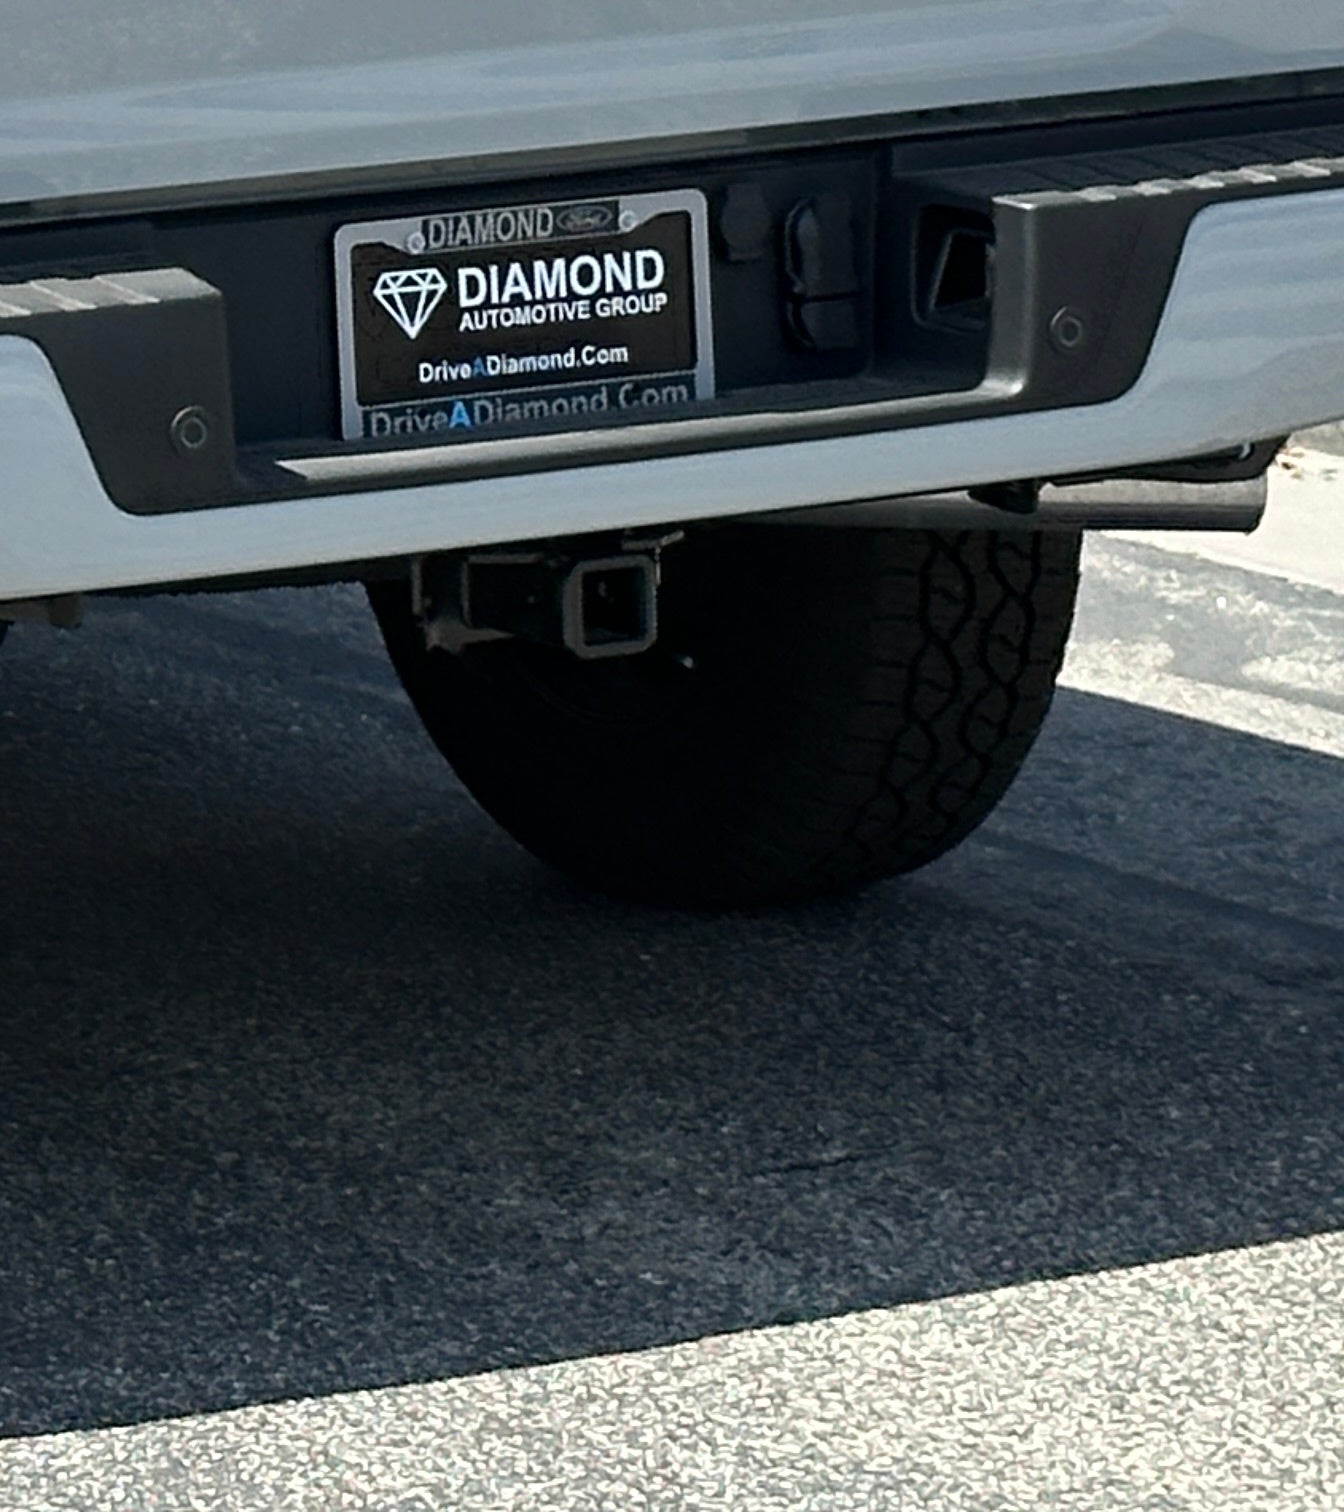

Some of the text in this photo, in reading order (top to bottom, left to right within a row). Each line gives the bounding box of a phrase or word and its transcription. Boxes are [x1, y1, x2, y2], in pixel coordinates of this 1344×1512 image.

[426, 206, 554, 249] DIAMOND
[457, 249, 664, 308] DIAMOND
[458, 291, 669, 333] AUTOMOTIVE GROUP
[418, 344, 630, 385] DriveADiamond.Com
[370, 382, 689, 438] DriveADiamond.Com
